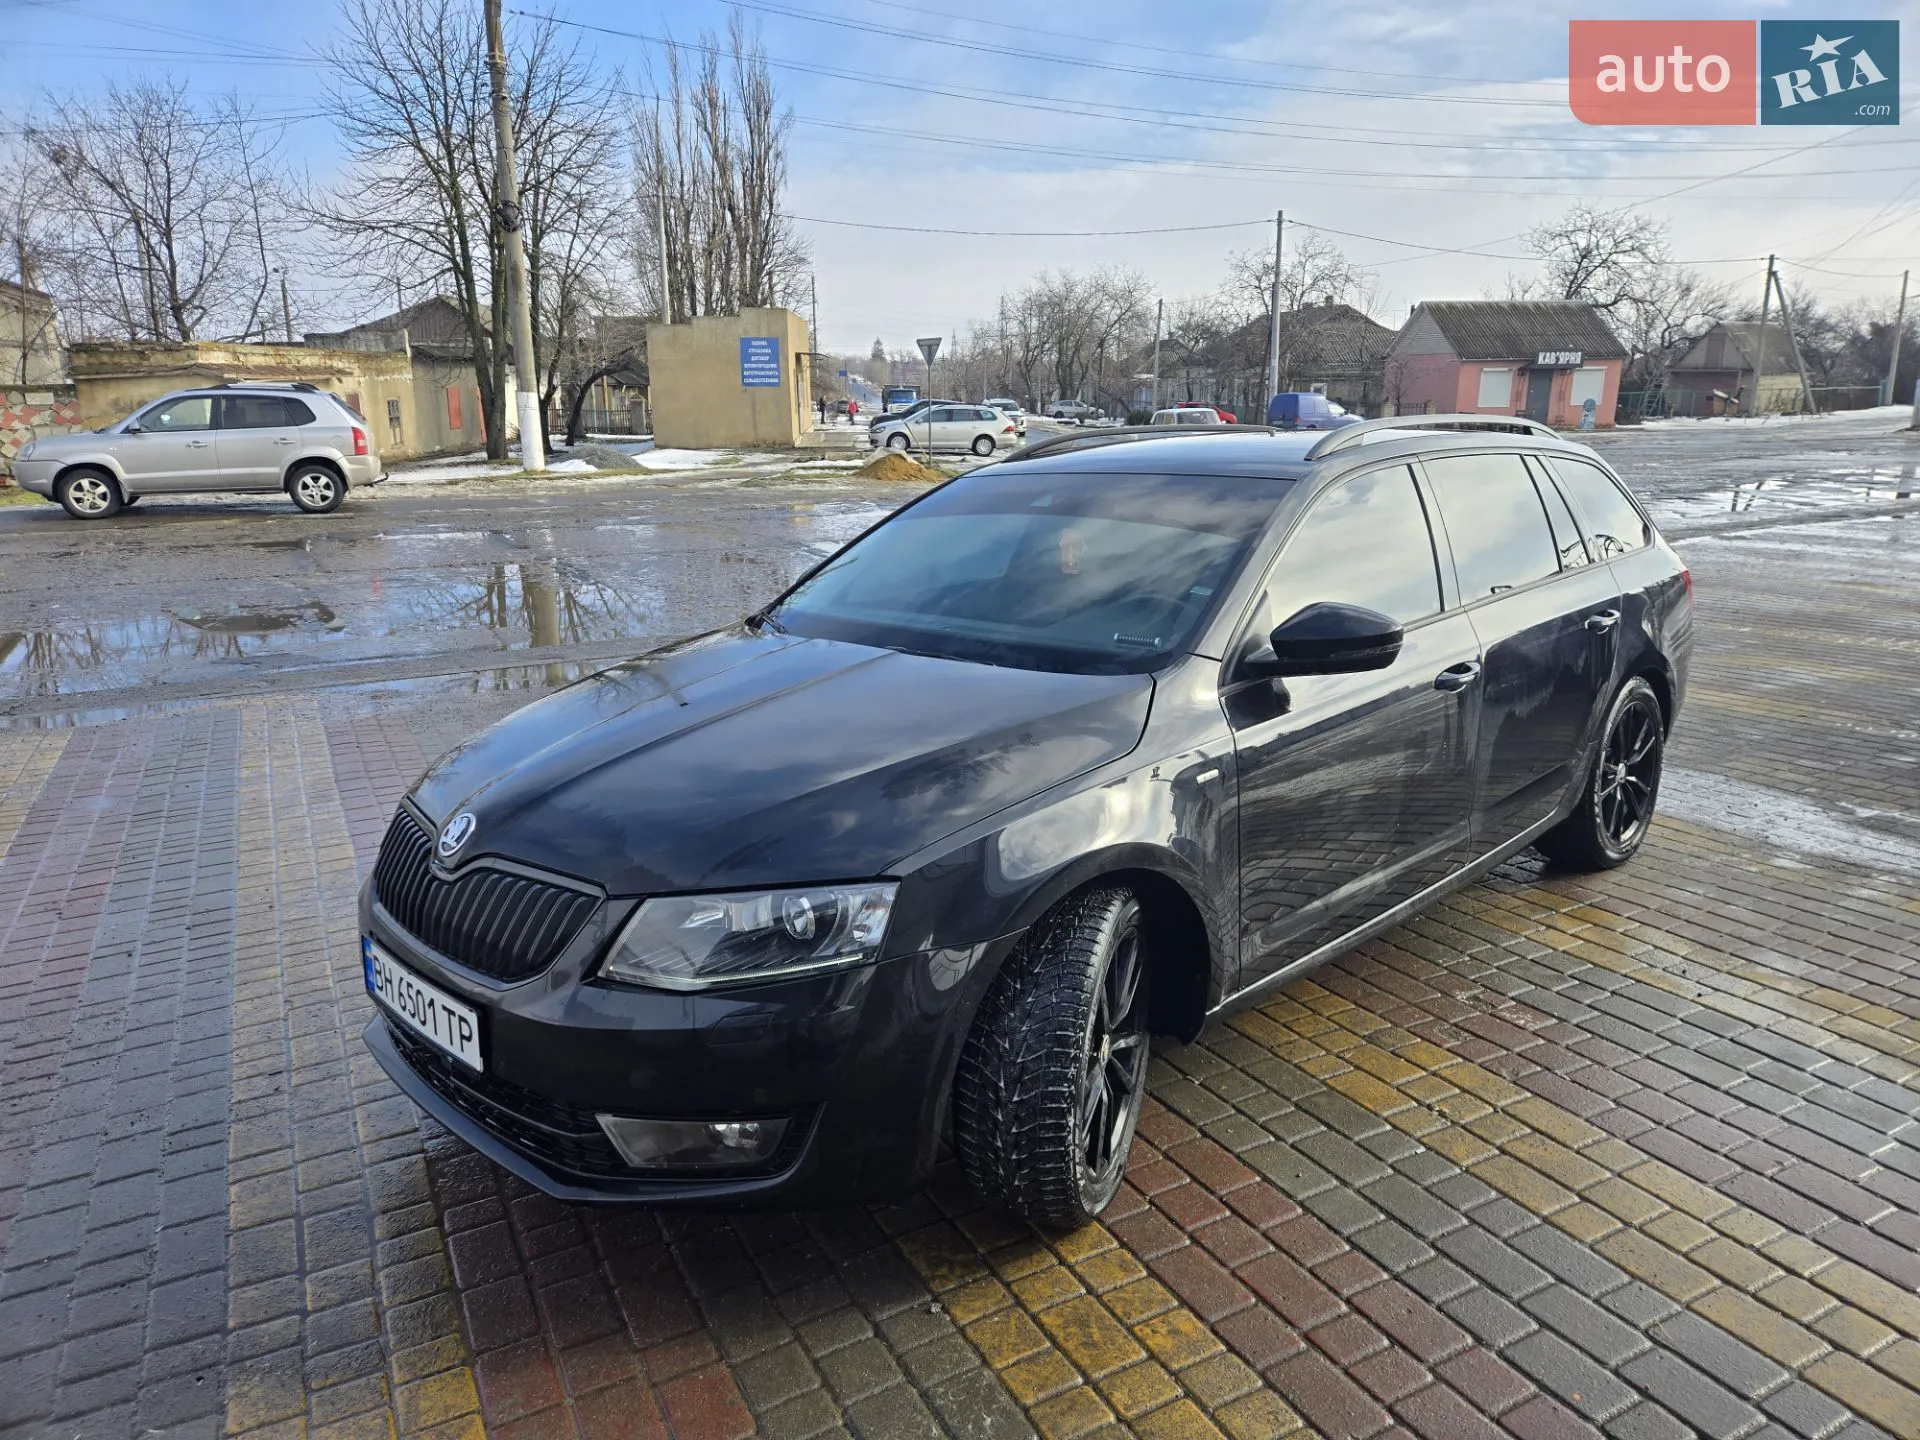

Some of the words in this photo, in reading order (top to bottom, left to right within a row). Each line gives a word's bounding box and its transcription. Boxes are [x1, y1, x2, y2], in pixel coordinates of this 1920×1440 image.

[1538, 351, 1582, 364] КАВ'ЯРНЯ
[373, 953, 395, 1004] BH
[398, 976, 438, 1036] 6501
[441, 1003, 473, 1053] TP
